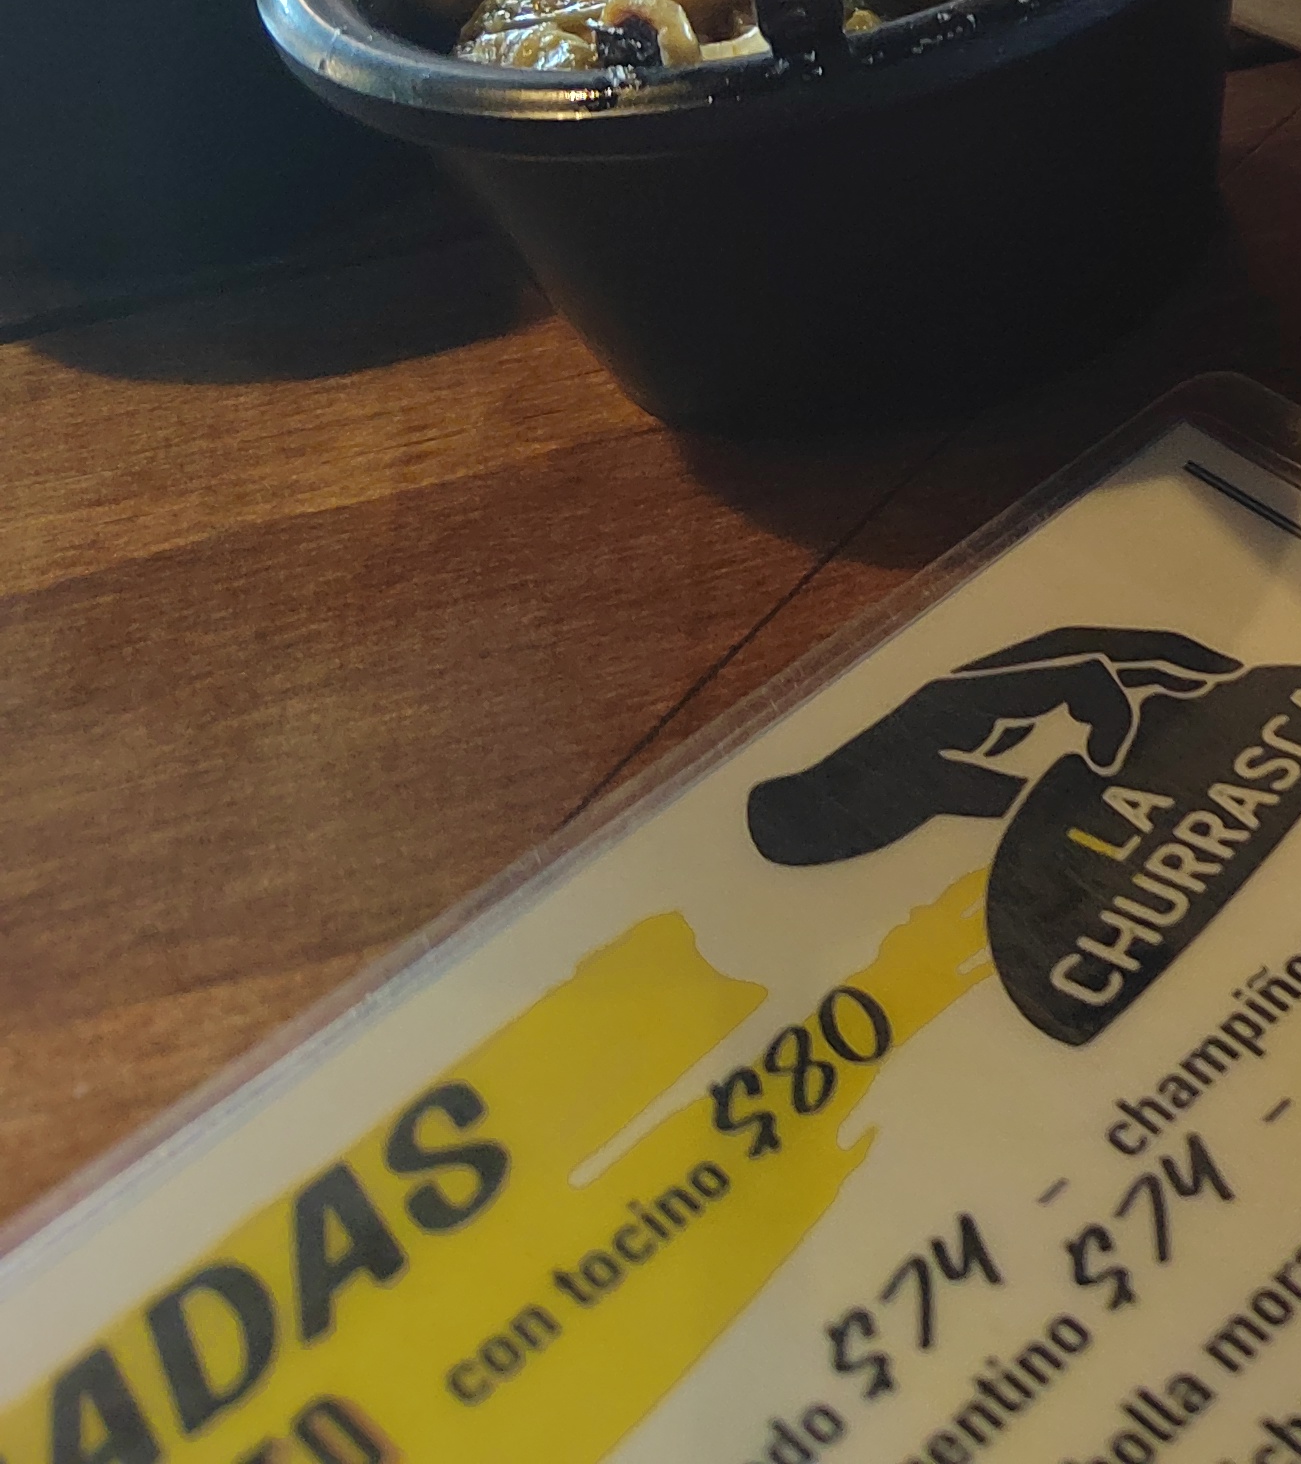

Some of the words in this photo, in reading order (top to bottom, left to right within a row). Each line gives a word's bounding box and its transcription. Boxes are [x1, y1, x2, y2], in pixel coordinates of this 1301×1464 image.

[1067, 785, 1176, 861] LA
[0, 1079, 511, 1464] ADAS
[446, 1304, 562, 1407] con
[551, 1160, 731, 1308] tocino
[708, 985, 892, 1159] $80
[825, 1211, 1003, 1400] $74
[905, 1313, 1091, 1464] entino
[1066, 1132, 1236, 1311] $74
[1064, 1371, 1216, 1464] olla
